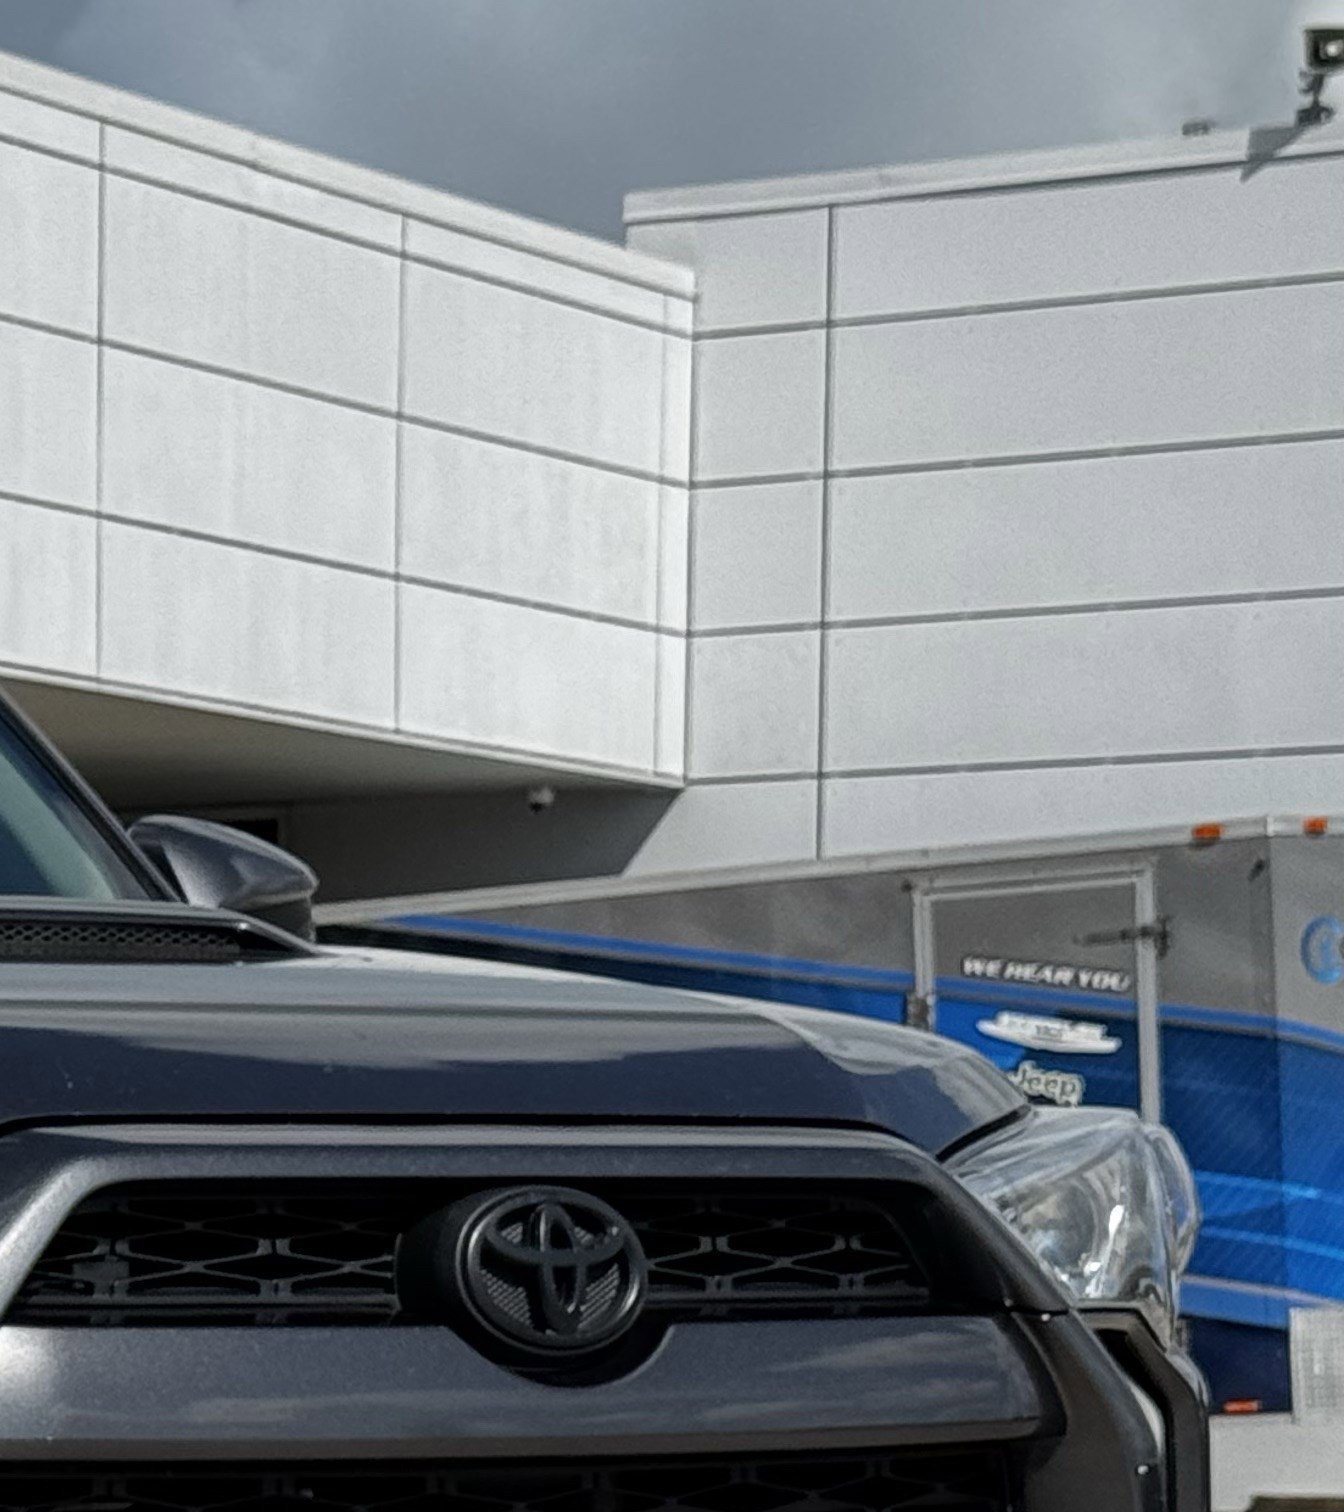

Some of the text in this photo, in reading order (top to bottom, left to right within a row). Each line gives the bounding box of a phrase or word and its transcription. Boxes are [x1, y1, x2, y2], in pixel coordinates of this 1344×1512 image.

[963, 956, 1132, 993] WE HEAR YOU
[1007, 1060, 1085, 1106] Jeep
